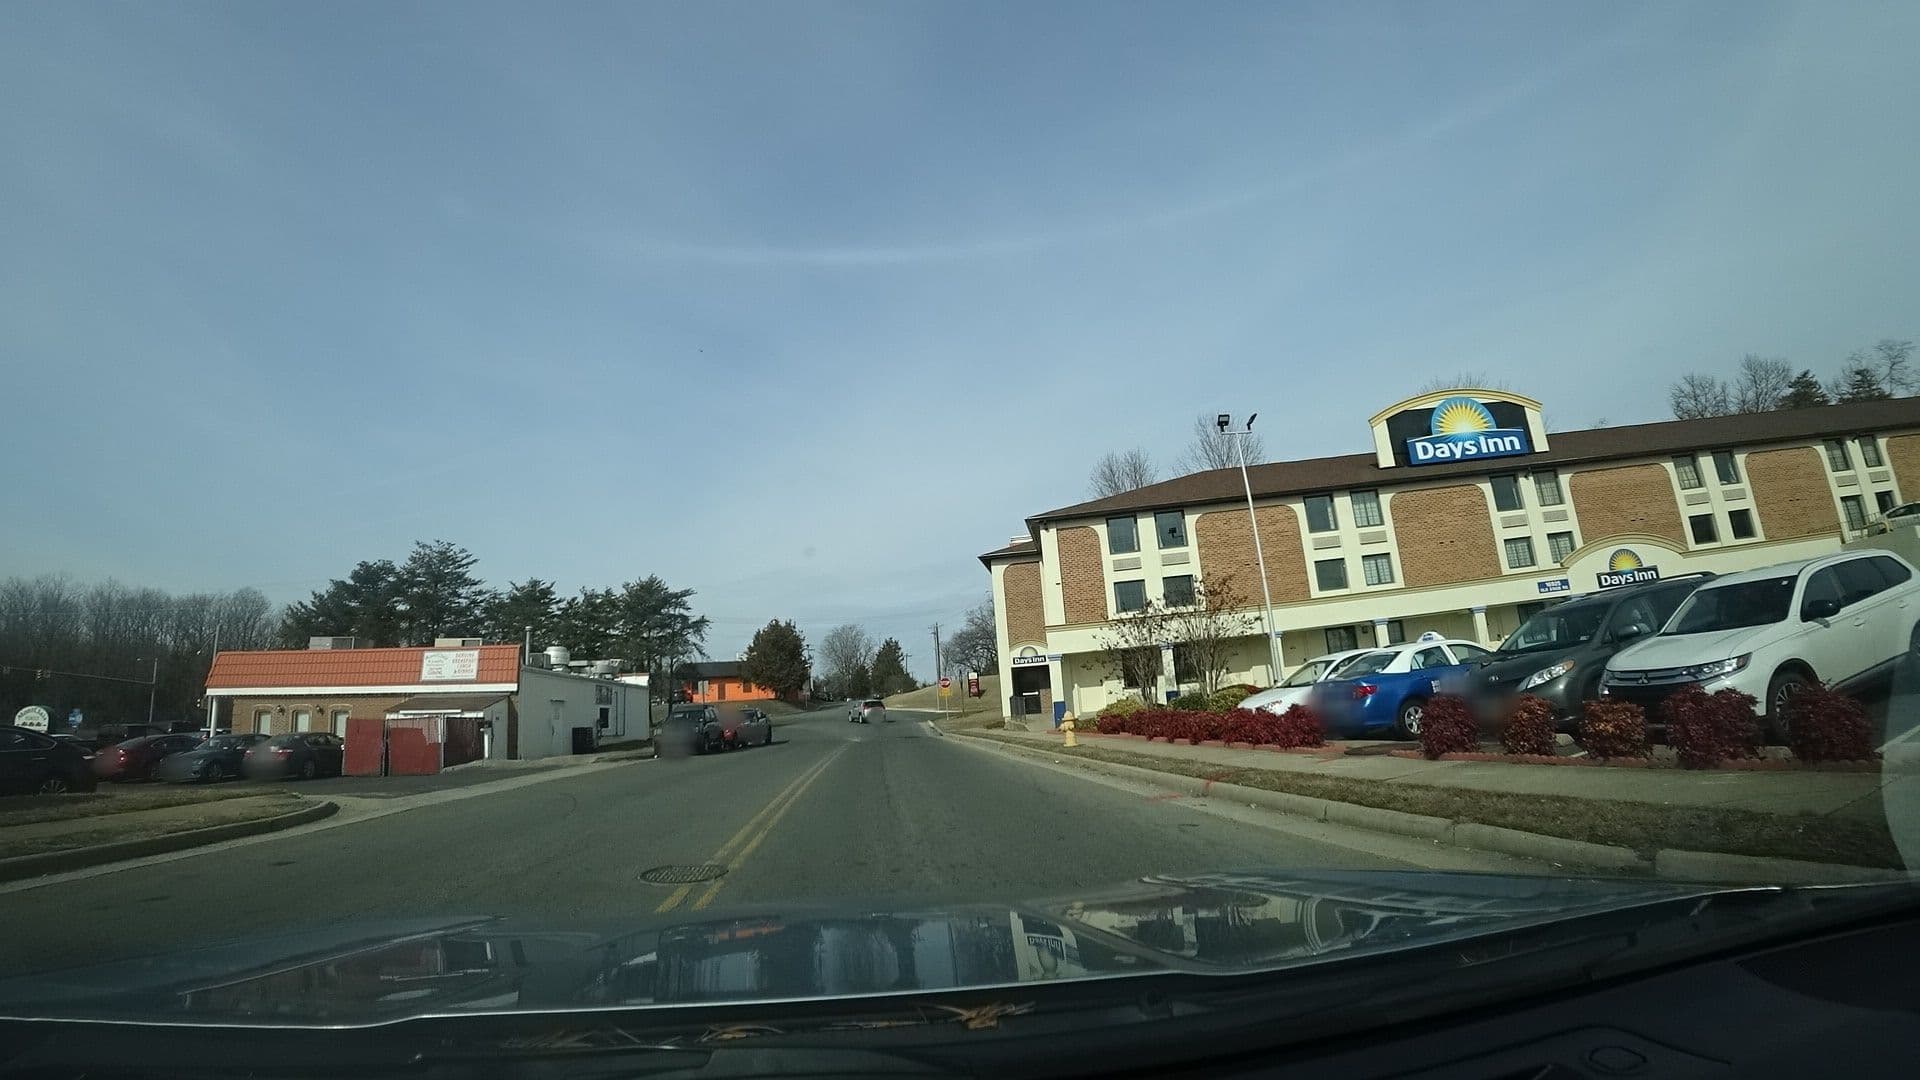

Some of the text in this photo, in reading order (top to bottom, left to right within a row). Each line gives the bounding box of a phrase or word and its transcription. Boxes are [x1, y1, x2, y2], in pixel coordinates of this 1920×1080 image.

[1415, 436, 1521, 459] Days Inn
[1601, 570, 1657, 586] Days Inn
